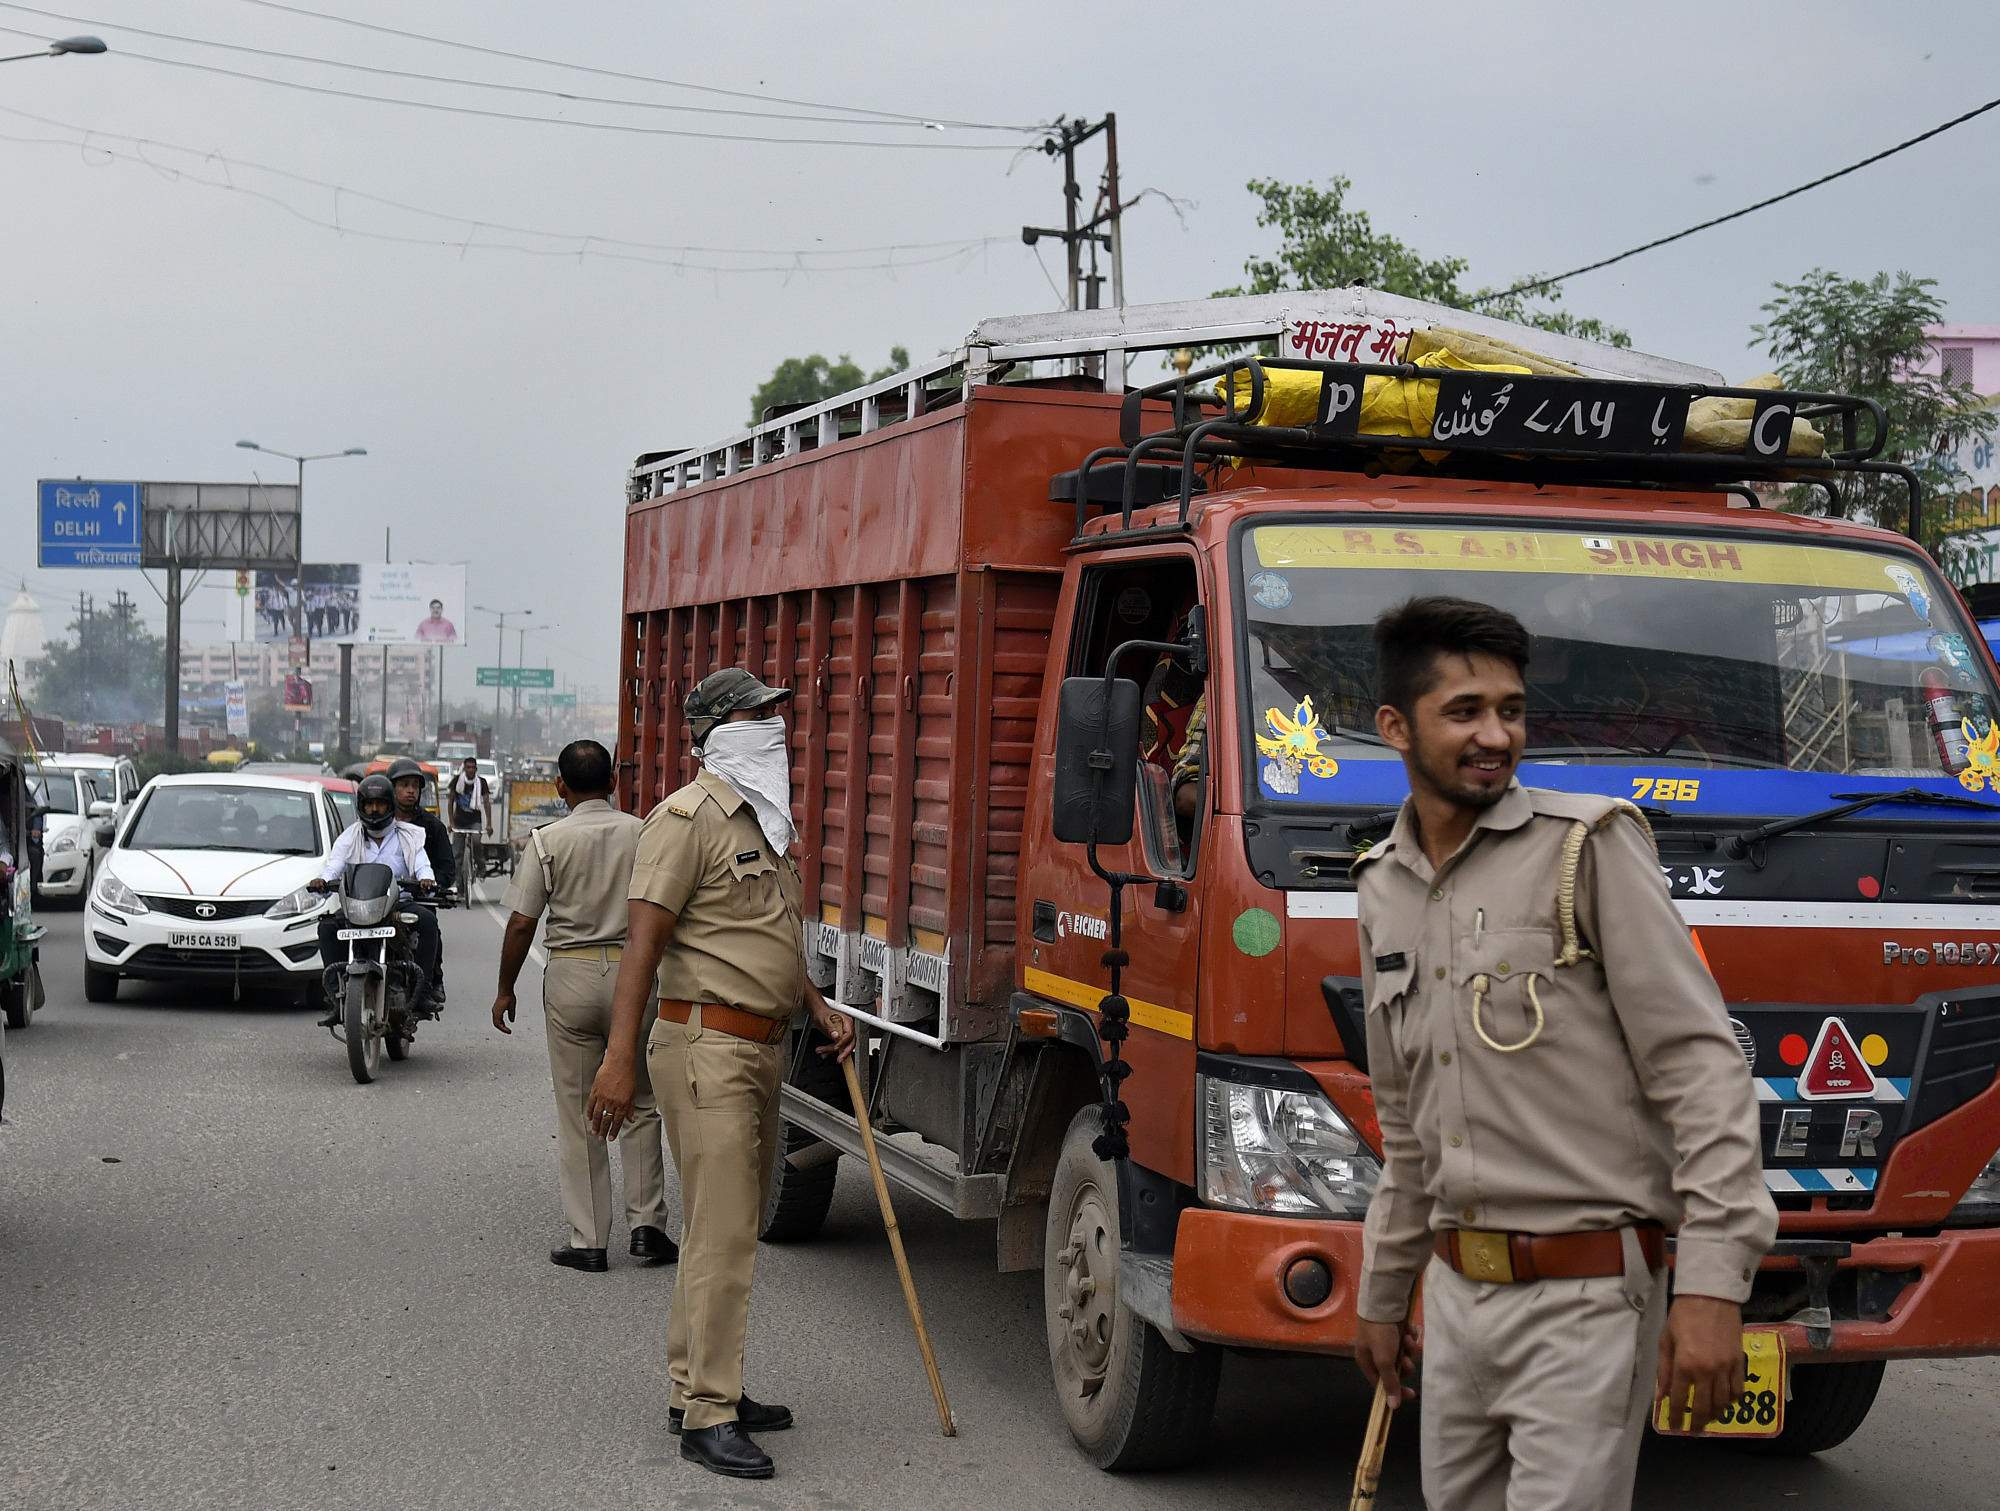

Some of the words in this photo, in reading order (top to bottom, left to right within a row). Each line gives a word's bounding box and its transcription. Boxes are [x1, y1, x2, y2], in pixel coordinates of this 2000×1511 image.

[1974, 443, 1994, 470] OF
[56, 488, 100, 508] दिल्ली
[54, 520, 100, 536] DELHI
[1590, 540, 1743, 571] SINGH
[1631, 778, 1700, 802] 786
[1073, 914, 1107, 940] EICHER
[172, 934, 196, 946] UP15
[198, 935, 212, 946] CA
[214, 936, 237, 948] 5219
[1883, 942, 1930, 965] Pro
